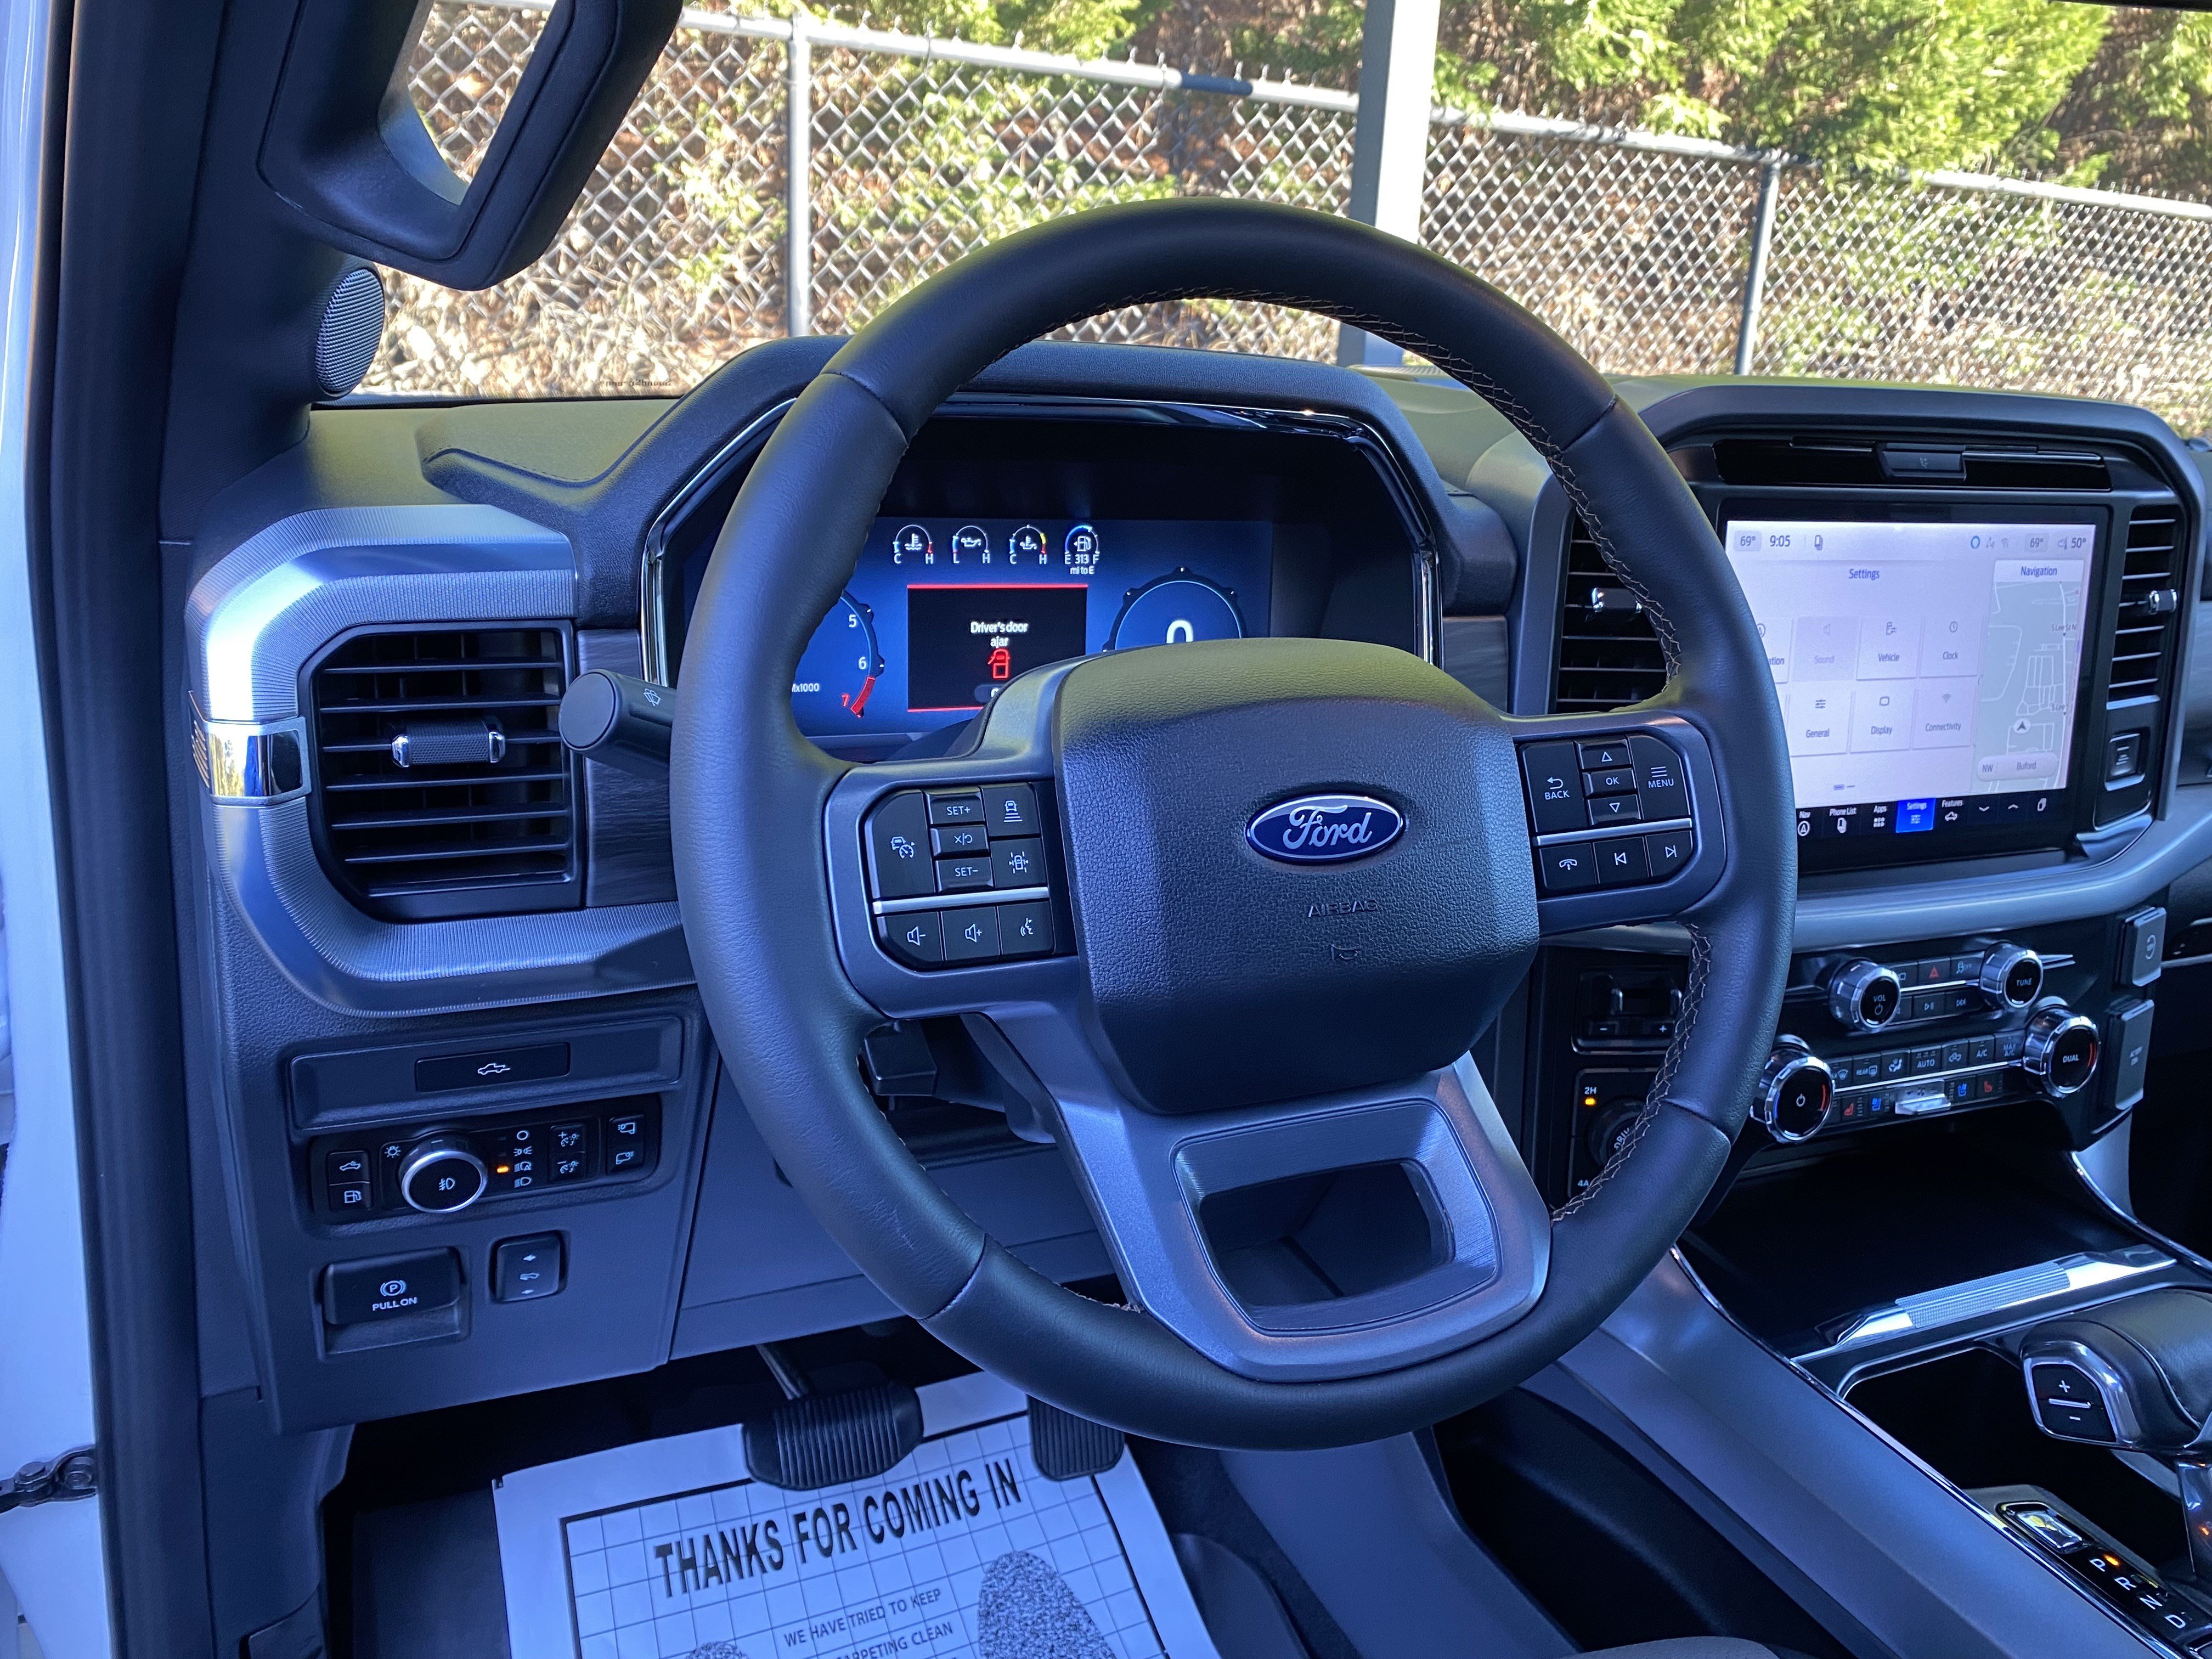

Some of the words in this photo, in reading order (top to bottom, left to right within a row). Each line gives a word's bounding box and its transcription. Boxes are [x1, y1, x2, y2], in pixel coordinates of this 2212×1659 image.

[1740, 535, 1756, 546] 69°
[1770, 535, 1791, 547] 9:05
[2029, 538, 2044, 548] 69°
[2071, 537, 2086, 548] 50°
[894, 553, 901, 564] C
[925, 553, 933, 564] H
[953, 553, 960, 564] L
[982, 553, 990, 564] H
[1009, 554, 1017, 564] C
[1039, 554, 1047, 565] H
[1064, 554, 1071, 565] E
[1075, 554, 1090, 565] 313
[1092, 554, 1099, 565] F
[1070, 566, 1080, 574] mi
[1088, 566, 1095, 574] E
[1849, 568, 1880, 580] Settings
[2020, 566, 2058, 577] Navigation
[848, 614, 857, 628] 5
[970, 621, 1005, 633] Driver's
[1006, 620, 1029, 633] door
[990, 635, 1009, 648] ajar
[1878, 652, 1900, 662] Vehicle
[1942, 651, 1959, 660] Clock
[858, 656, 867, 670] 6
[842, 693, 850, 707] 7
[1870, 725, 1893, 736] Display
[1925, 722, 1962, 732] Connectivity
[1806, 728, 1830, 738] General
[1982, 764, 1993, 773] NW
[2016, 760, 2037, 771] Buford
[1605, 776, 1620, 786] OK
[1647, 778, 1674, 789] MENU
[1544, 789, 1570, 800] BACK
[1906, 801, 1927, 811] Settings
[1942, 799, 1963, 808] Features
[946, 805, 971, 816] SET+
[1799, 810, 1810, 819] Nav
[1829, 808, 1847, 816] Phone
[1847, 806, 1857, 815] List
[1873, 805, 1887, 814] Apps
[1282, 804, 1373, 850] Ford
[1308, 900, 1379, 918] AIRBAG
[2016, 978, 2033, 986] TUNE
[1873, 994, 1886, 1002] VOL
[1976, 1048, 1988, 1058] A/C
[2062, 1054, 2080, 1063] DUAL
[1917, 1059, 1936, 1068] AUTO
[1584, 1086, 1597, 1094] 2H
[372, 1300, 399, 1312] PULL
[400, 1296, 417, 1306] ON
[653, 1519, 785, 1599] THANKS
[793, 1502, 857, 1564] FOR
[863, 1469, 981, 1544] COMING
[985, 1457, 1022, 1510] IN
[2089, 1558, 2106, 1572] P
[2114, 1576, 2137, 1591] R
[2139, 1594, 2163, 1610] N
[783, 1629, 807, 1647] WE
[808, 1617, 847, 1640] HAVE
[848, 1605, 887, 1629] TRIED
[888, 1598, 907, 1615] TO
[910, 1588, 941, 1609] KEEP
[2164, 1615, 2186, 1629] D
[835, 1636, 909, 1659] RPETING
[911, 1621, 954, 1646] CLEAN
